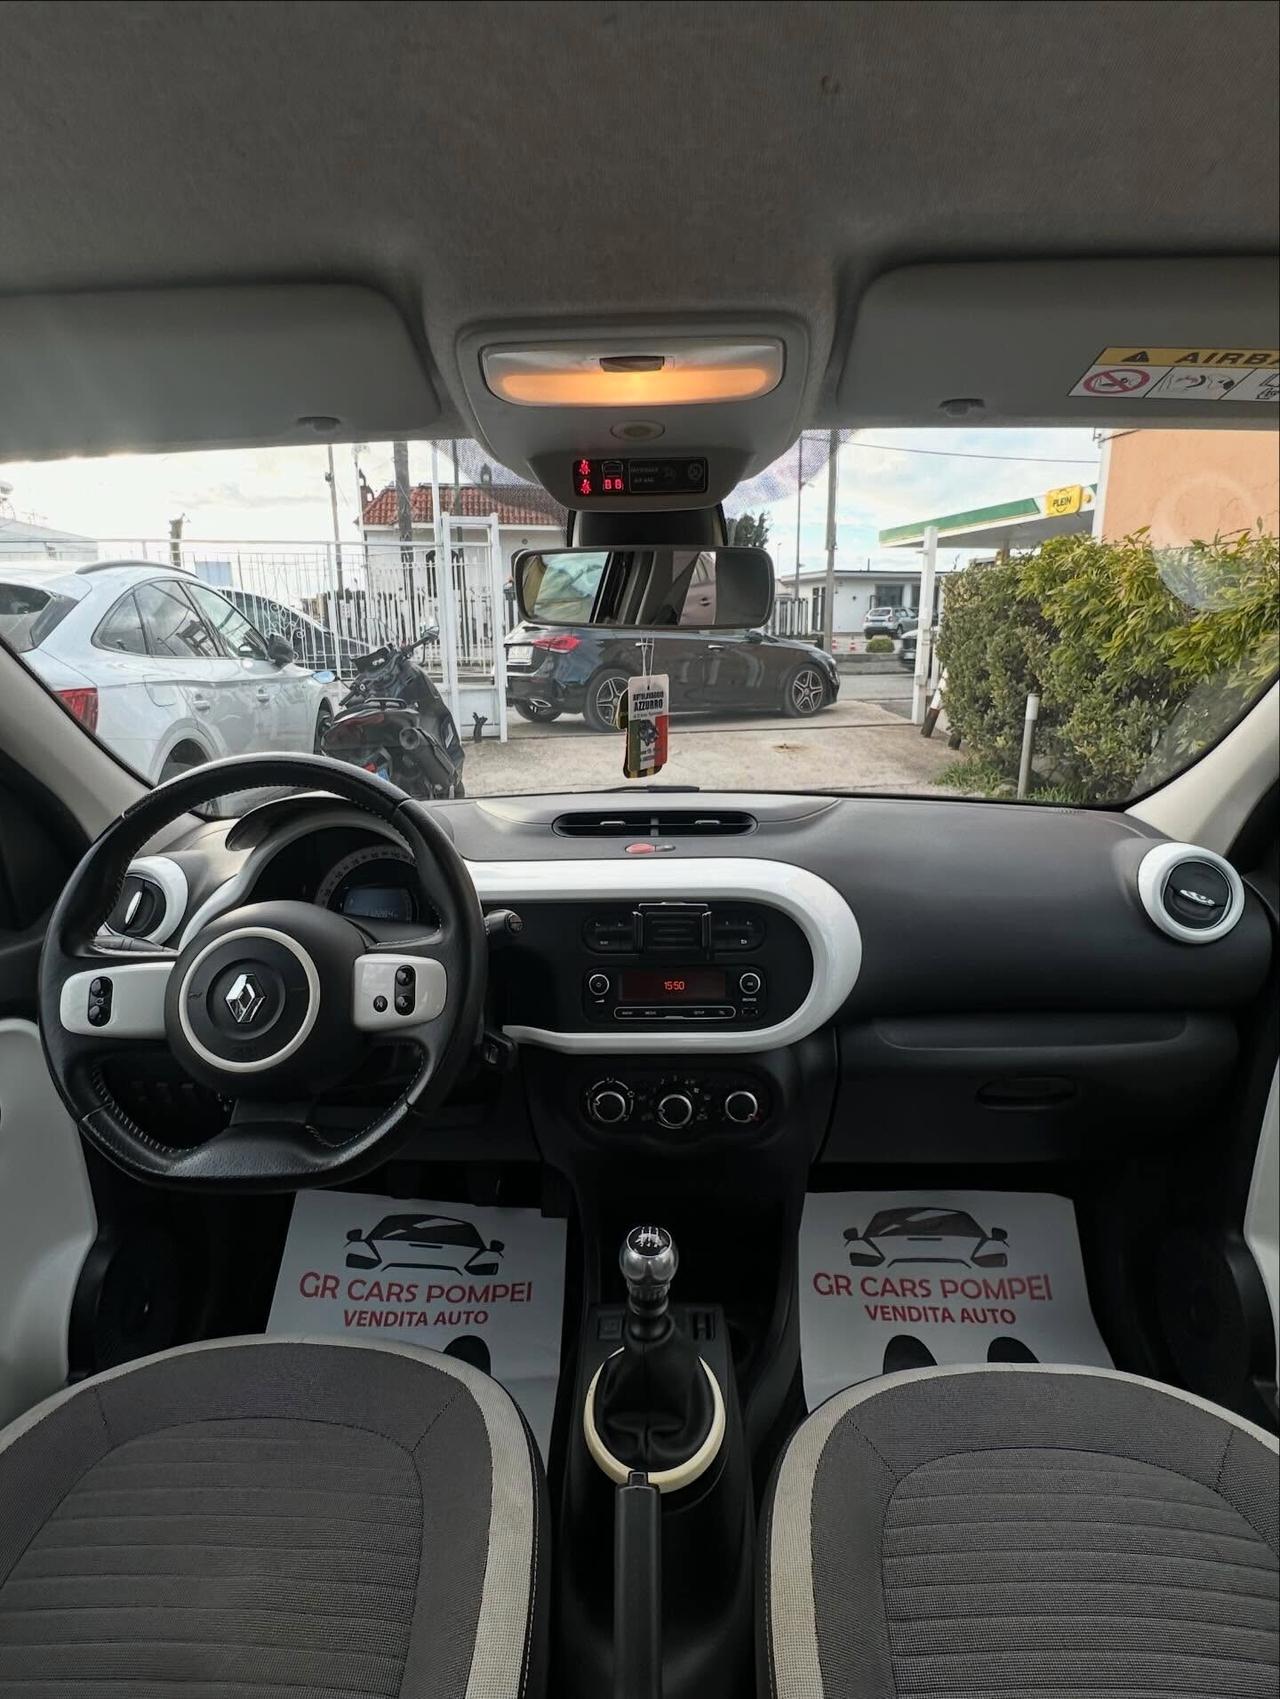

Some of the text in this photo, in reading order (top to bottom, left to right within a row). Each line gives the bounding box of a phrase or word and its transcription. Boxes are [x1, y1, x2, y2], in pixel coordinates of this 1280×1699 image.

[633, 699, 663, 711] AZZURRO
[299, 1271, 533, 1304] GR CARS POMPEI
[812, 1272, 1054, 1301] GR CARS POMPEI
[343, 1309, 489, 1328] VENDITA AUTO
[864, 1304, 1018, 1325] VENDITA AUTO
